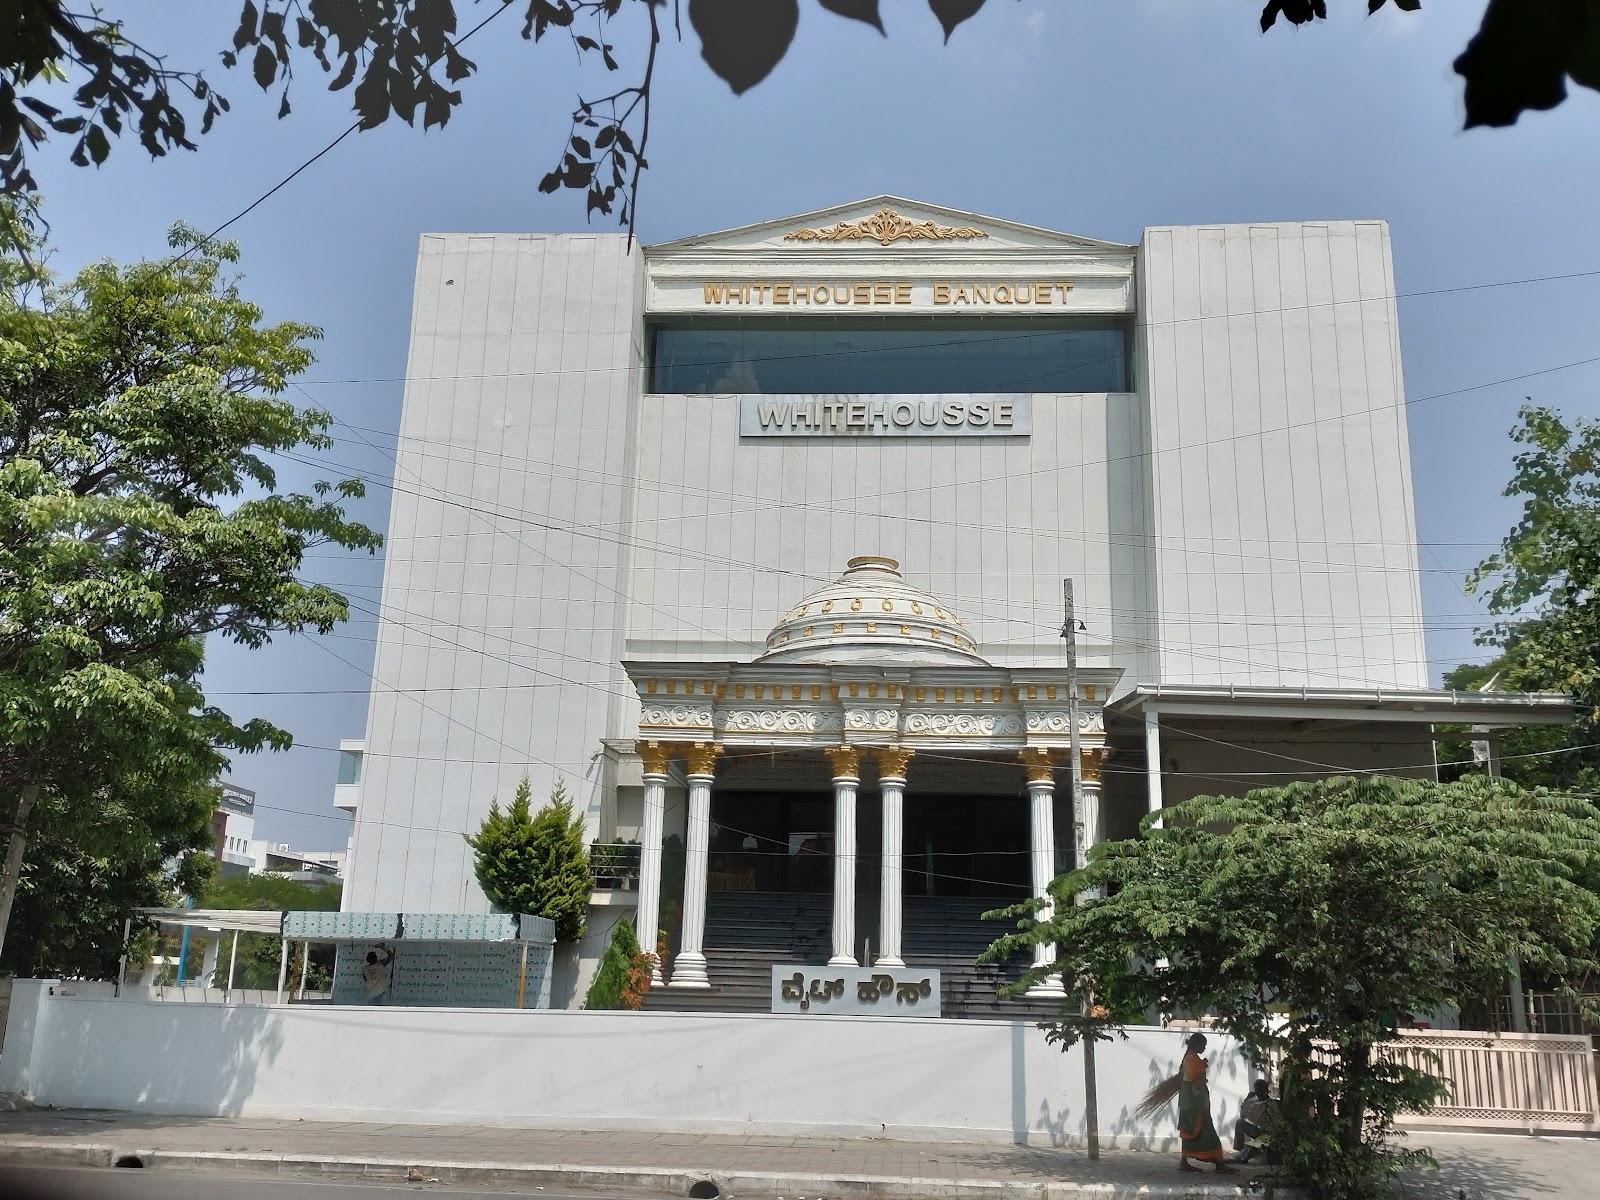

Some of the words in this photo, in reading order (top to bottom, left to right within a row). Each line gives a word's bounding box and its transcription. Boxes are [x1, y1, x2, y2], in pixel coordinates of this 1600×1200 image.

[703, 281, 912, 305] WHITEHOUSSE
[933, 281, 1074, 305] BANQUET
[758, 401, 1014, 427] WHITEHOUSSE
[781, 972, 845, 1010] ವೈಟ್
[857, 974, 931, 1007] ಹೌಸ್
